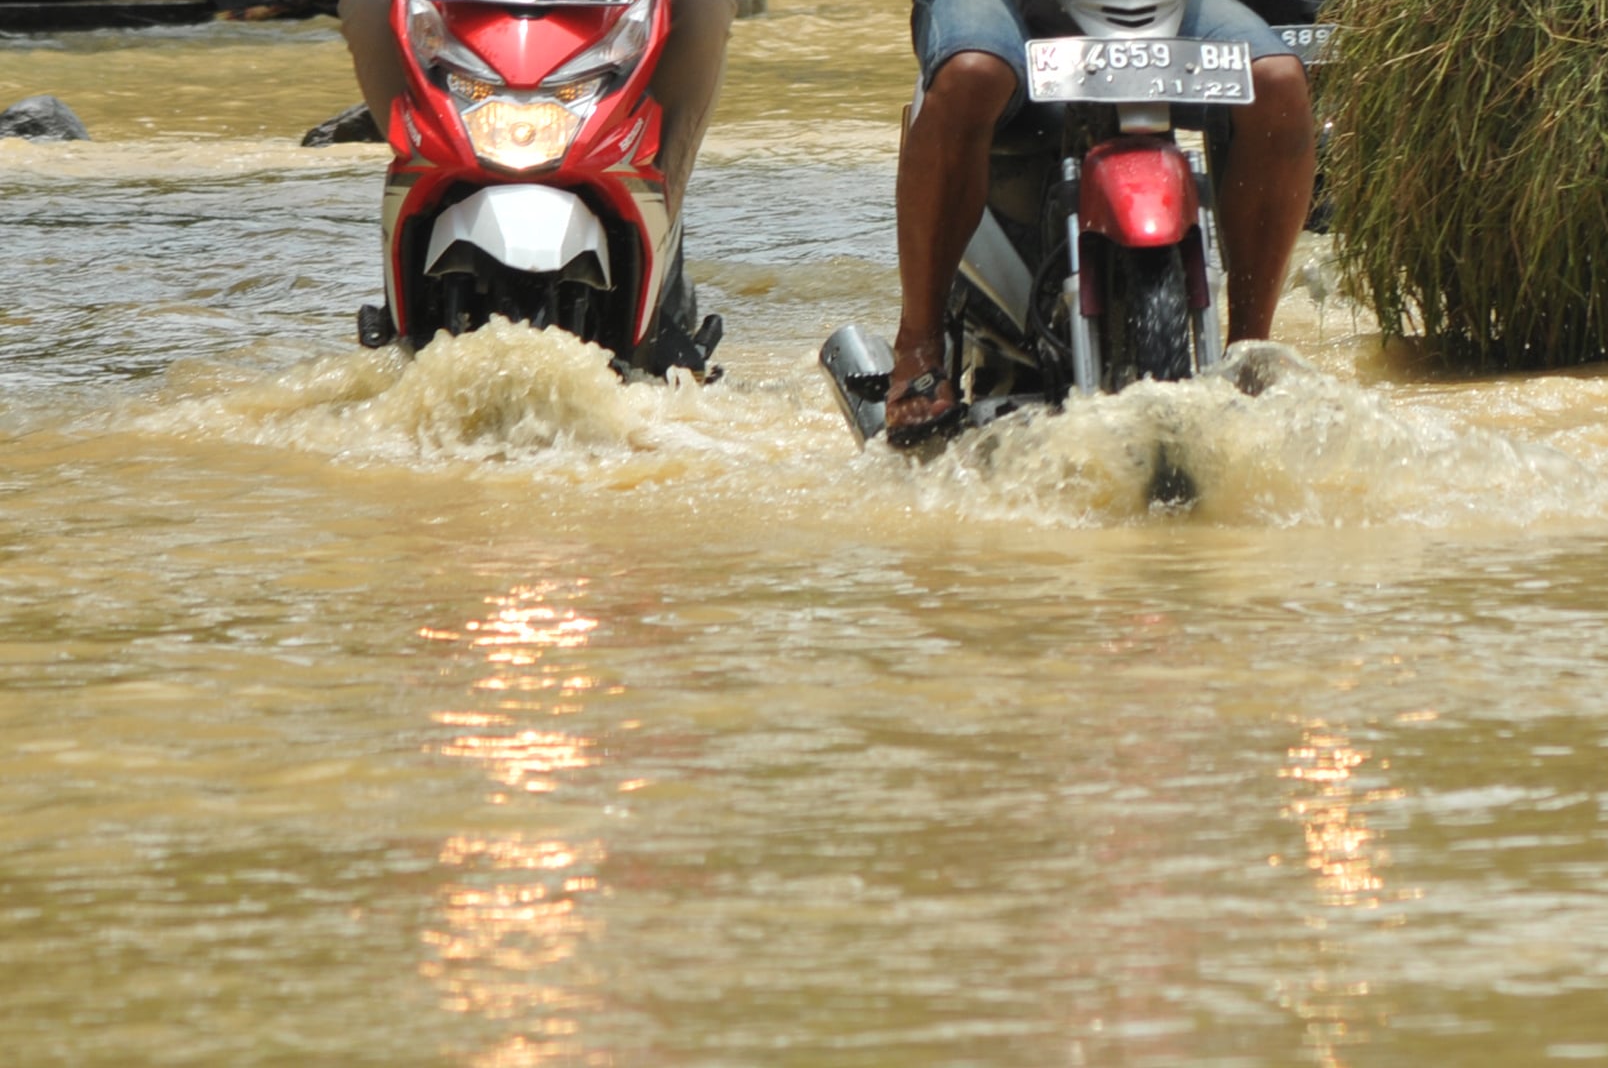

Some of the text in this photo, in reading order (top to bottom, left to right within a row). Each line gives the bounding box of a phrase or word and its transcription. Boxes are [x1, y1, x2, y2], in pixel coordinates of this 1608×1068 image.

[1036, 42, 1243, 71] K 4659 BH
